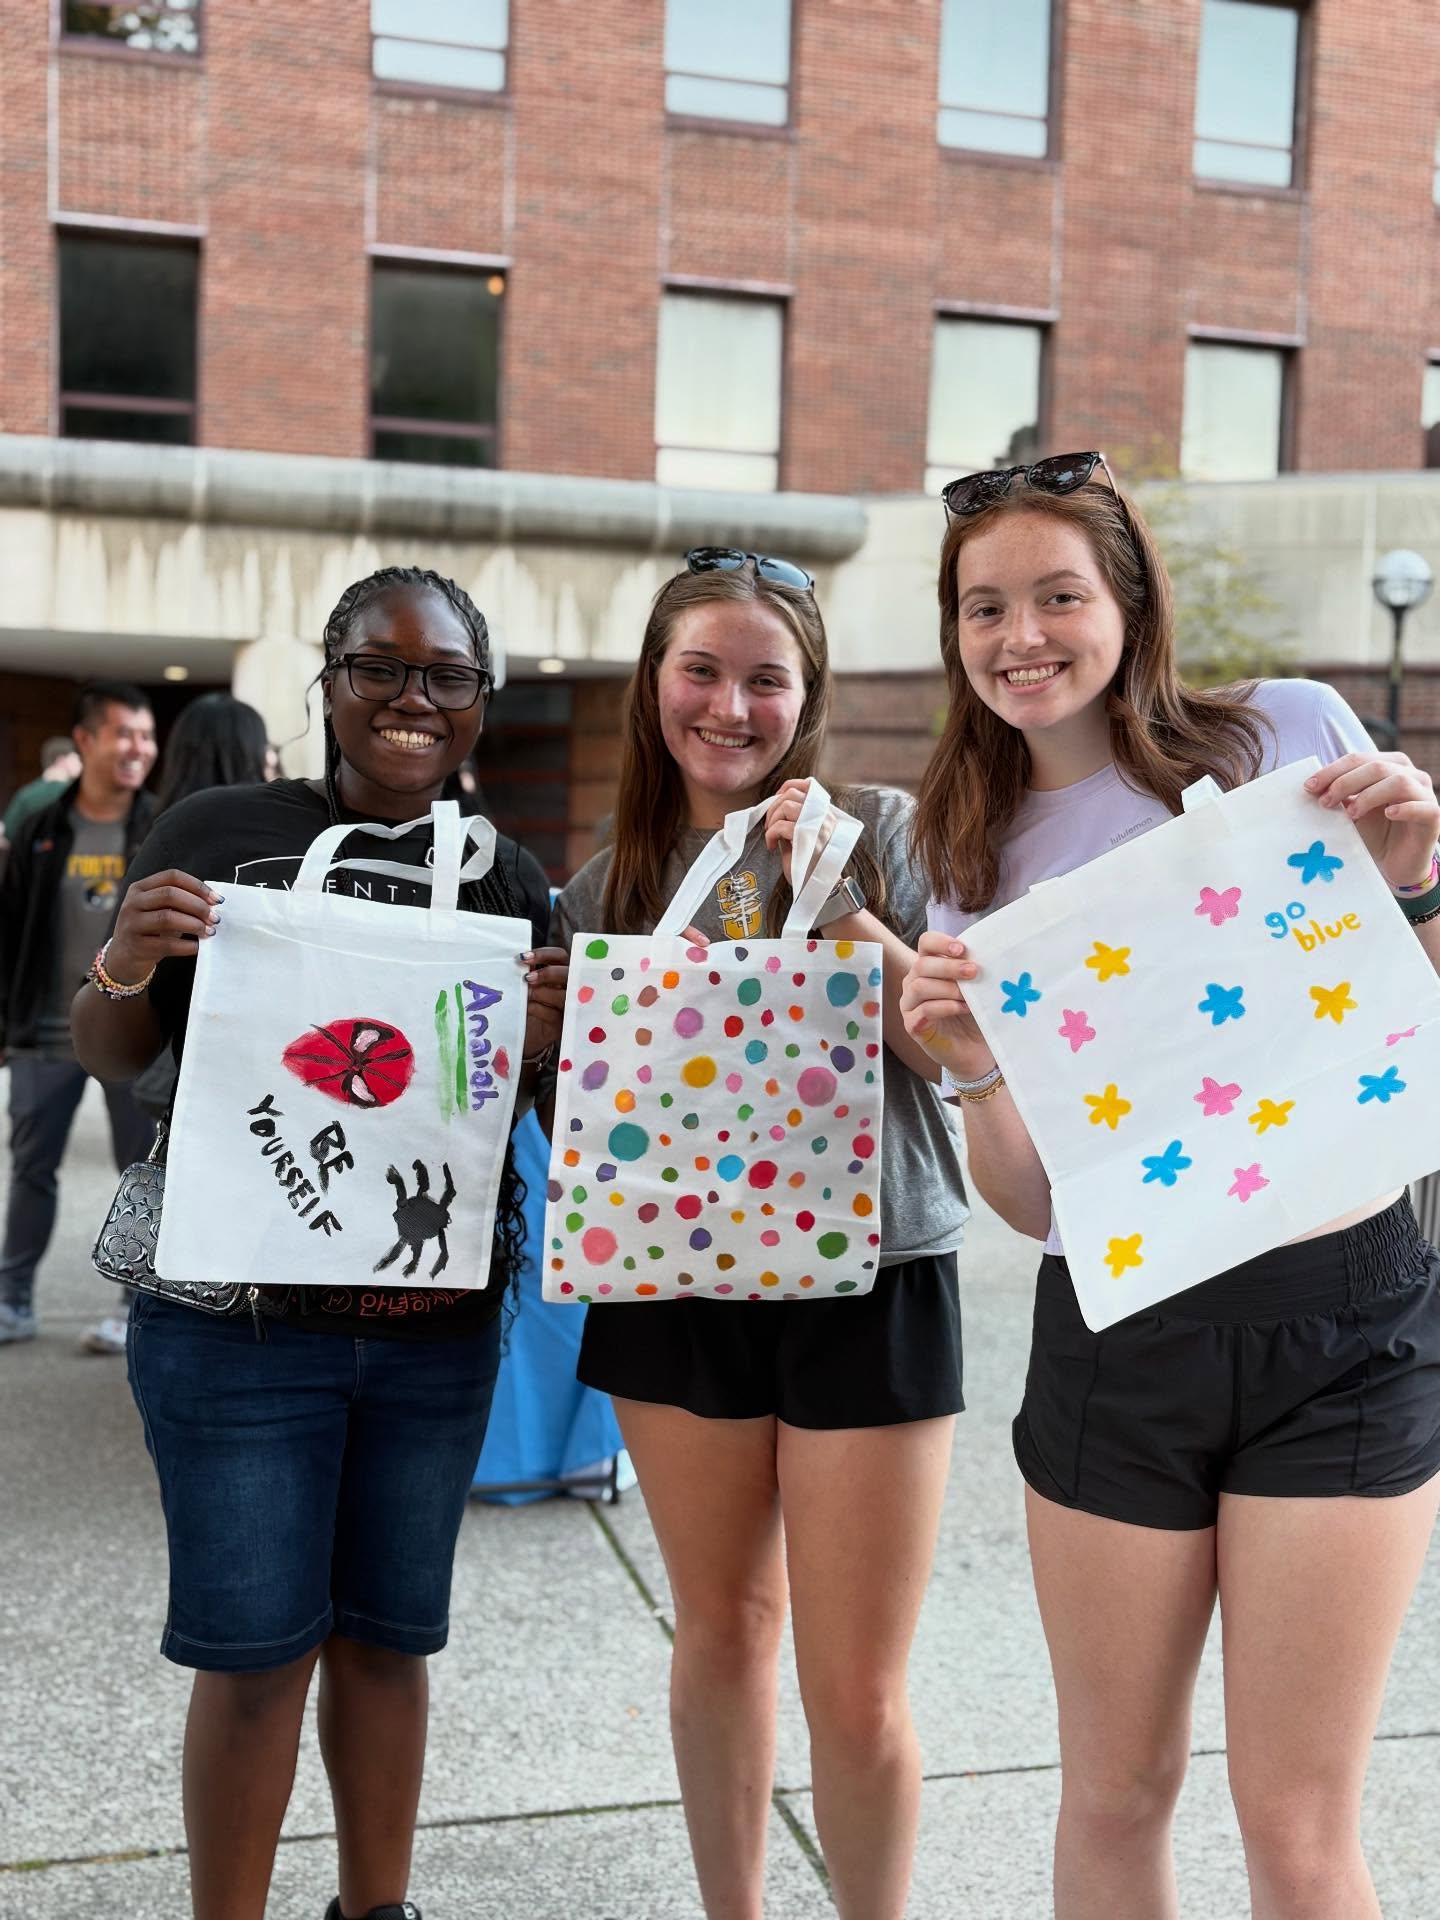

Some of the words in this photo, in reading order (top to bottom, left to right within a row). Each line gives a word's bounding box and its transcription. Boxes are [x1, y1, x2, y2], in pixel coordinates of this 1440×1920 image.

[1110, 817, 1153, 845] lululemon
[256, 879, 417, 903] ENT
[1265, 901, 1306, 939] go
[1291, 913, 1361, 952] blue
[247, 1094, 343, 1237] YOURSELF
[309, 1120, 355, 1196] BE
[360, 1288, 471, 1316] 안녕하세
